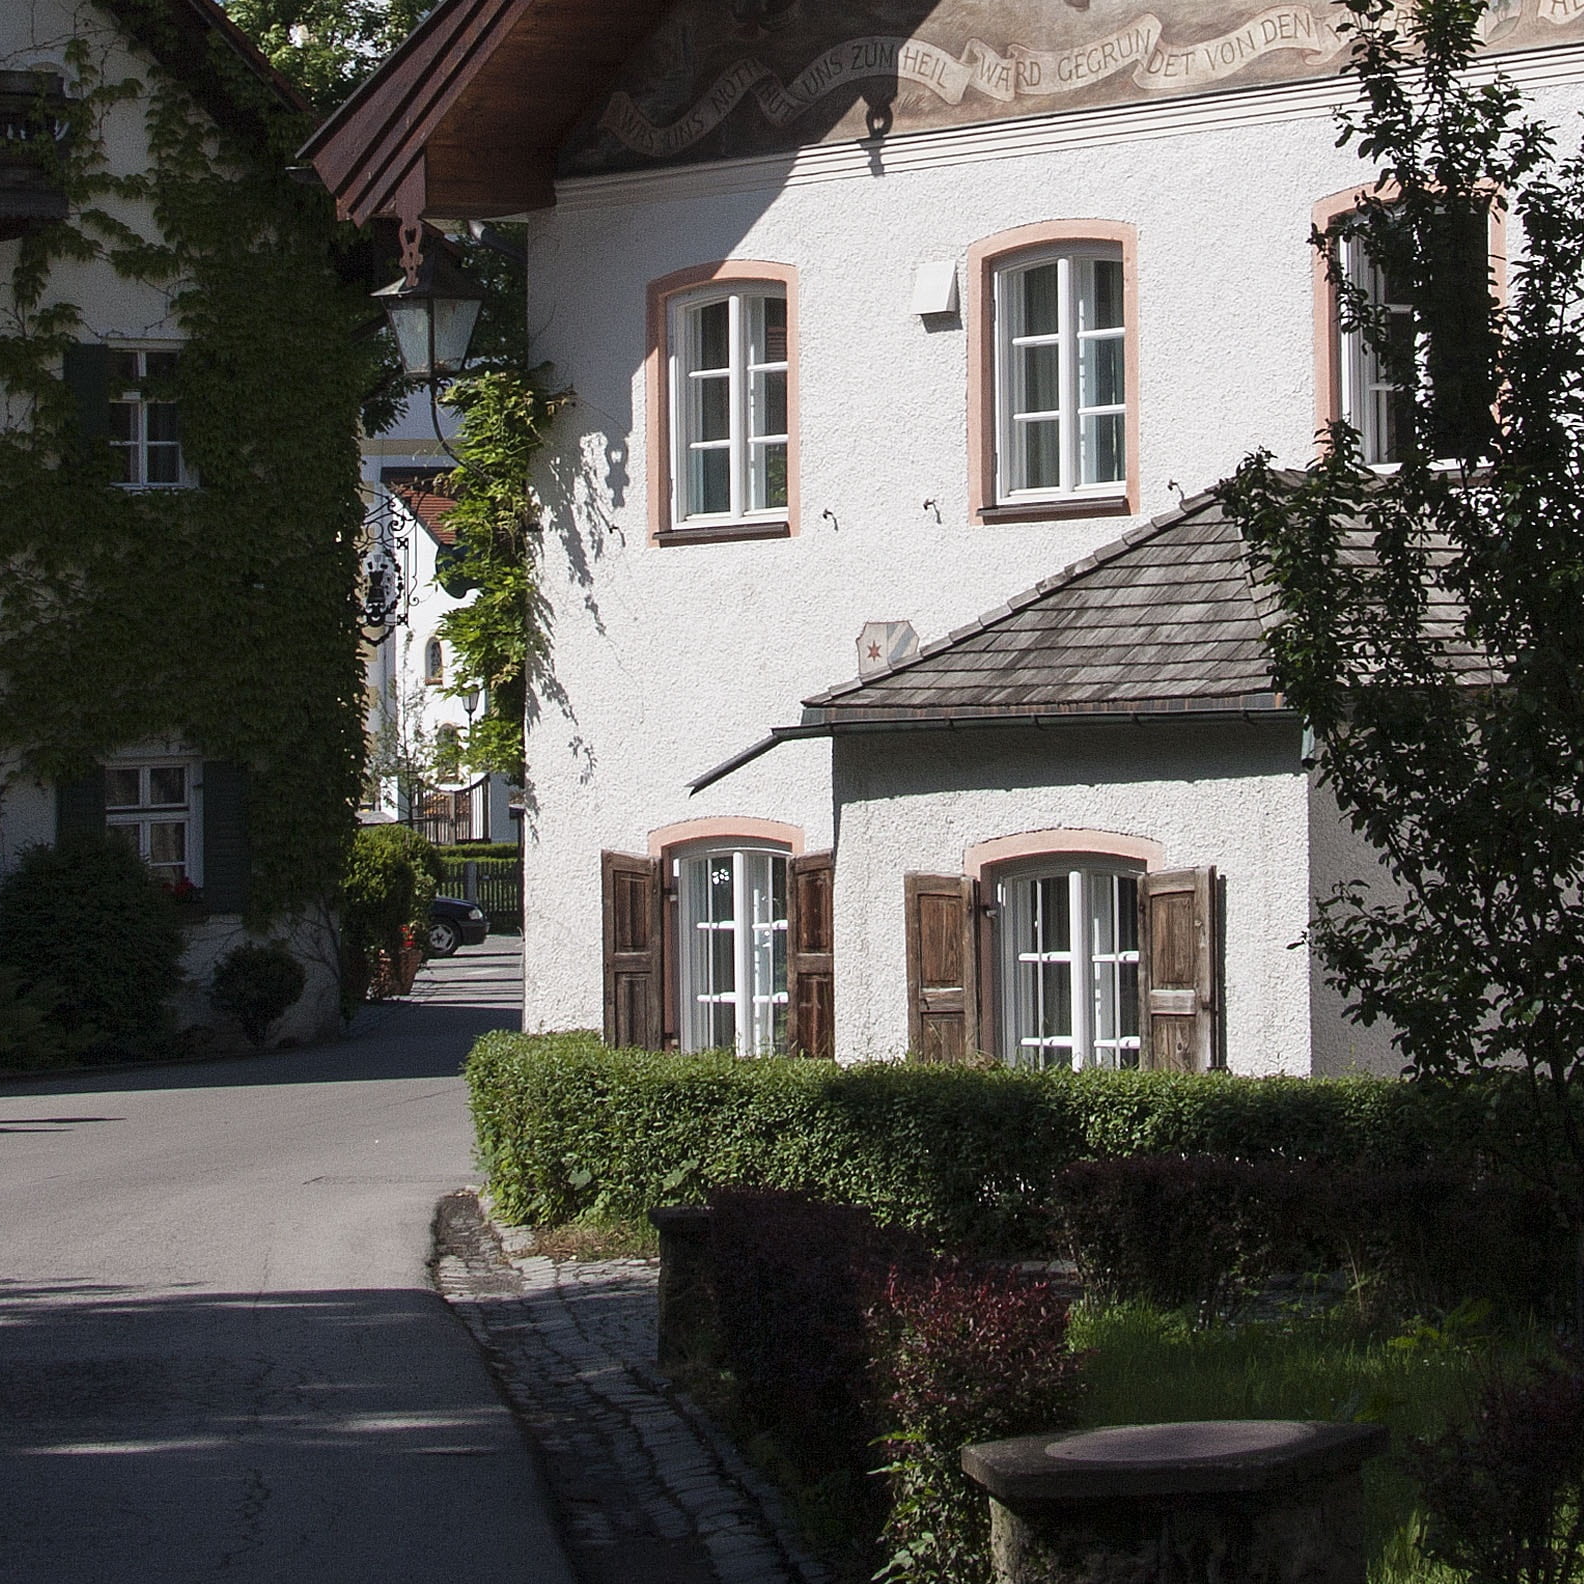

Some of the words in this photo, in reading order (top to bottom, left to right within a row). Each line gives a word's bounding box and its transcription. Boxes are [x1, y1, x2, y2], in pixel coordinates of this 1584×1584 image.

[666, 113, 705, 147] UNS
[801, 56, 843, 97] UNS
[851, 43, 895, 72] ZUM
[903, 46, 948, 90] HEIL
[978, 54, 1042, 93] WARD
[1205, 37, 1257, 72] VON
[1259, 12, 1312, 46] DEN
